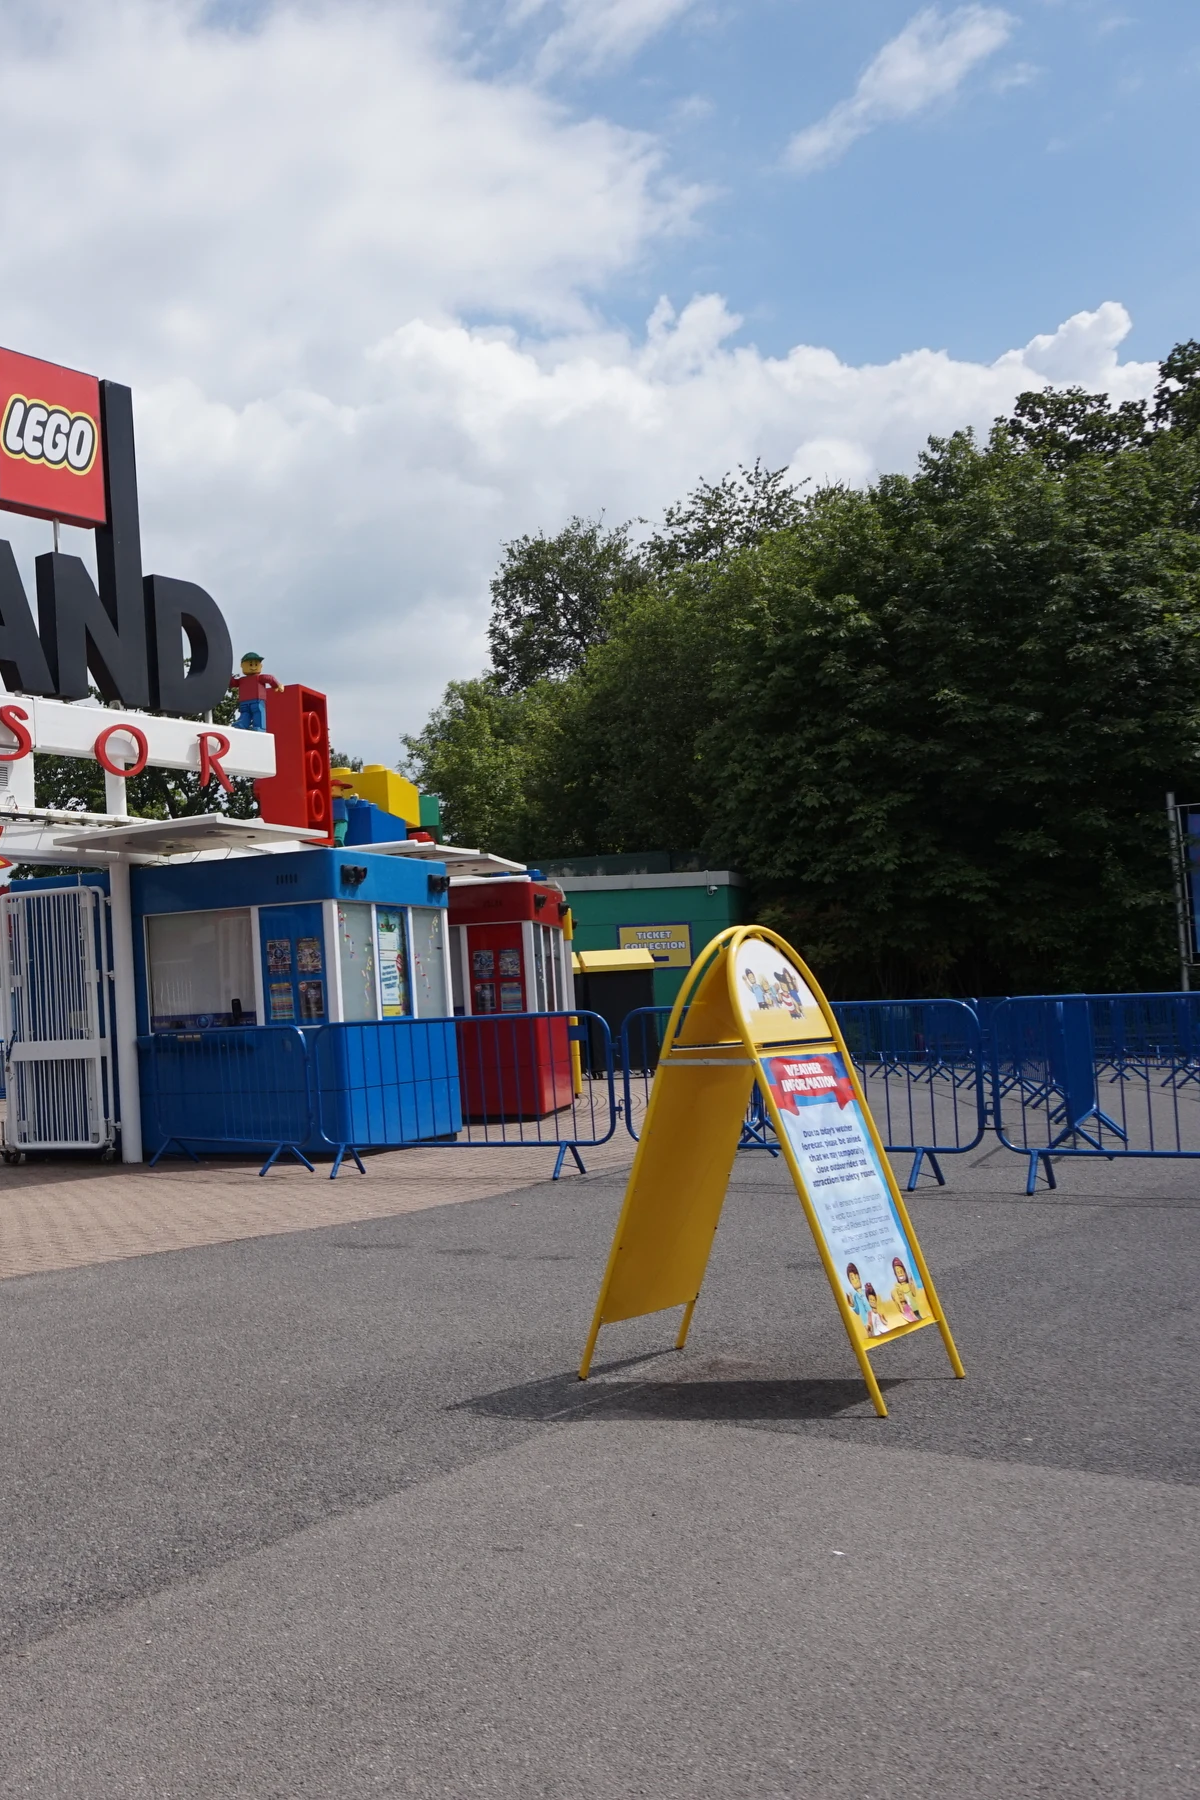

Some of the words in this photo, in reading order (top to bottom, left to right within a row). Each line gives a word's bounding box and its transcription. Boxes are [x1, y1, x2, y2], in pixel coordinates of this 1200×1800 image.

[4, 398, 95, 471] LEGO
[636, 931, 671, 940] TICKET
[624, 941, 687, 950] COLLECTION
[783, 1062, 824, 1076] WEATHER
[781, 1075, 837, 1092] INFORMATION
